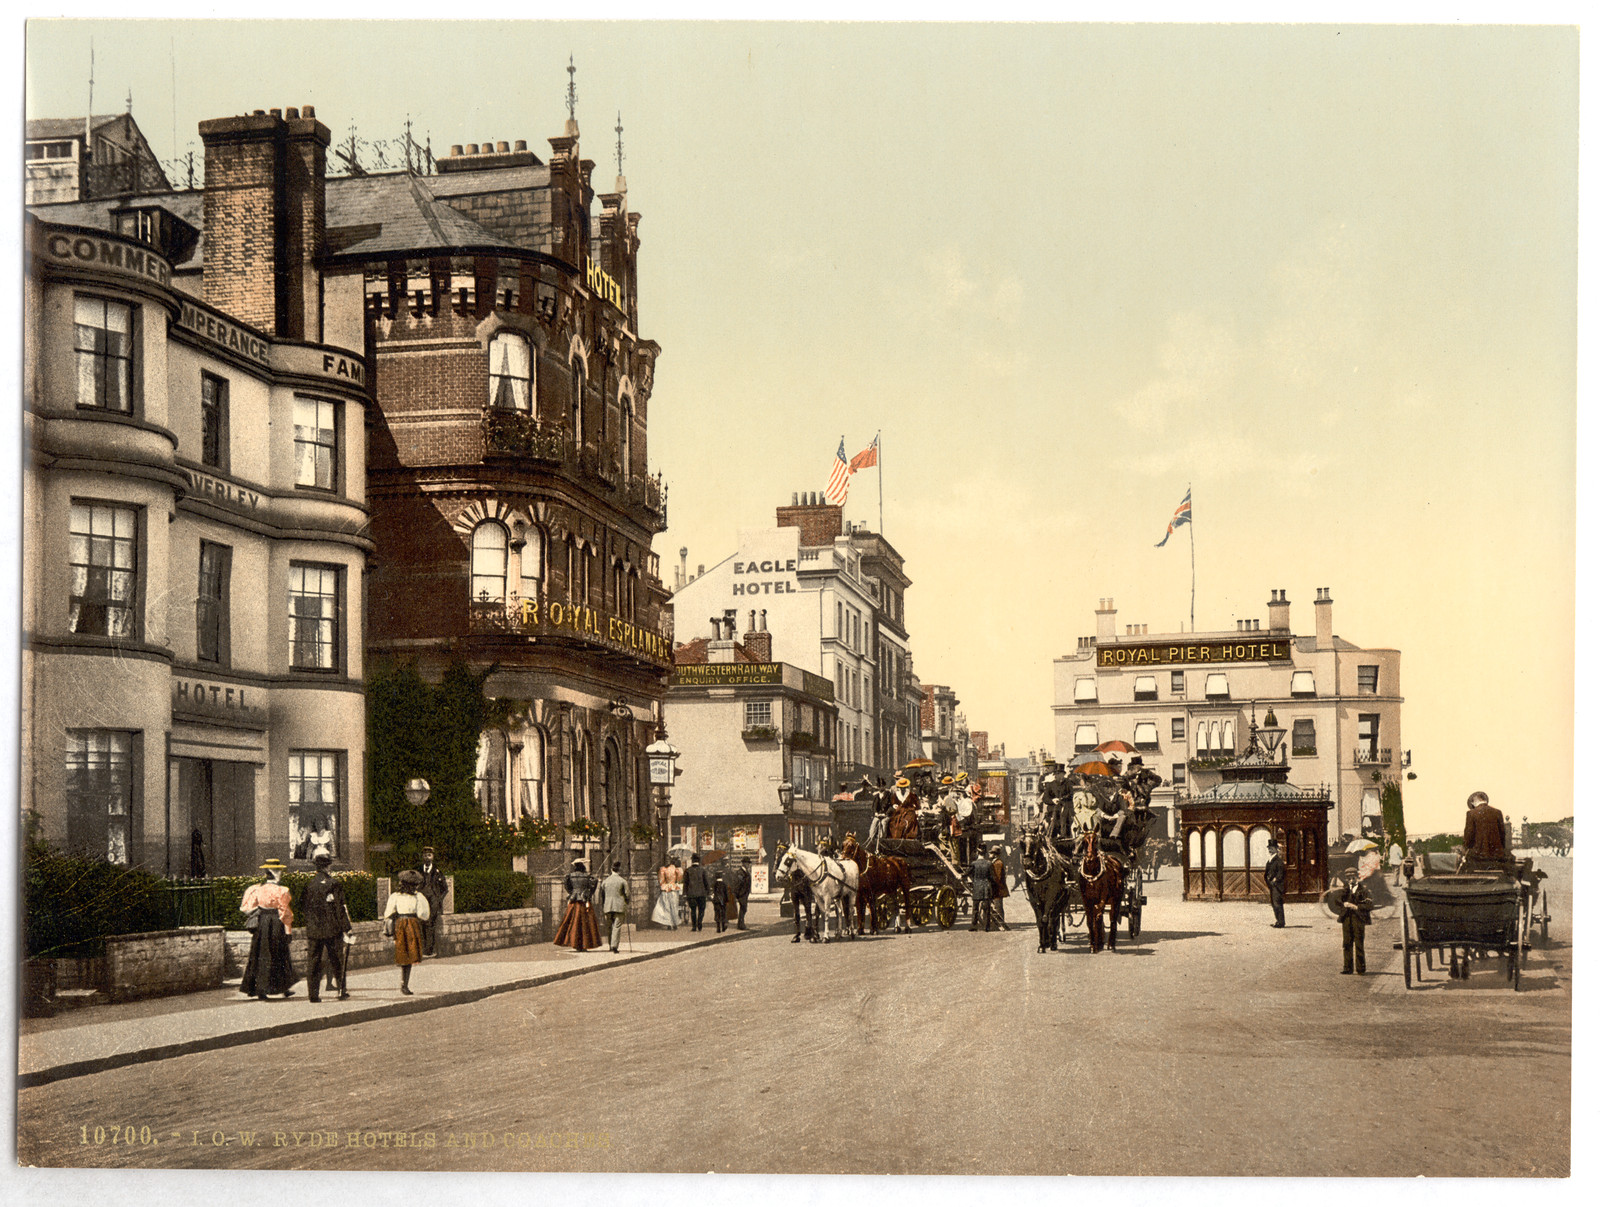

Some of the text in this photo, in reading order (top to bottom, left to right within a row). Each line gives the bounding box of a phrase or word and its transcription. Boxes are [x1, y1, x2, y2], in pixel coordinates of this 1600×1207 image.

[586, 255, 623, 311] HOTEL
[734, 560, 796, 574] EAGLE
[733, 581, 796, 595] HOTEL
[522, 599, 600, 635] ROYAL
[1103, 643, 1283, 663] ROYAL PIER HOTEL
[680, 676, 721, 685] ENQUIRY
